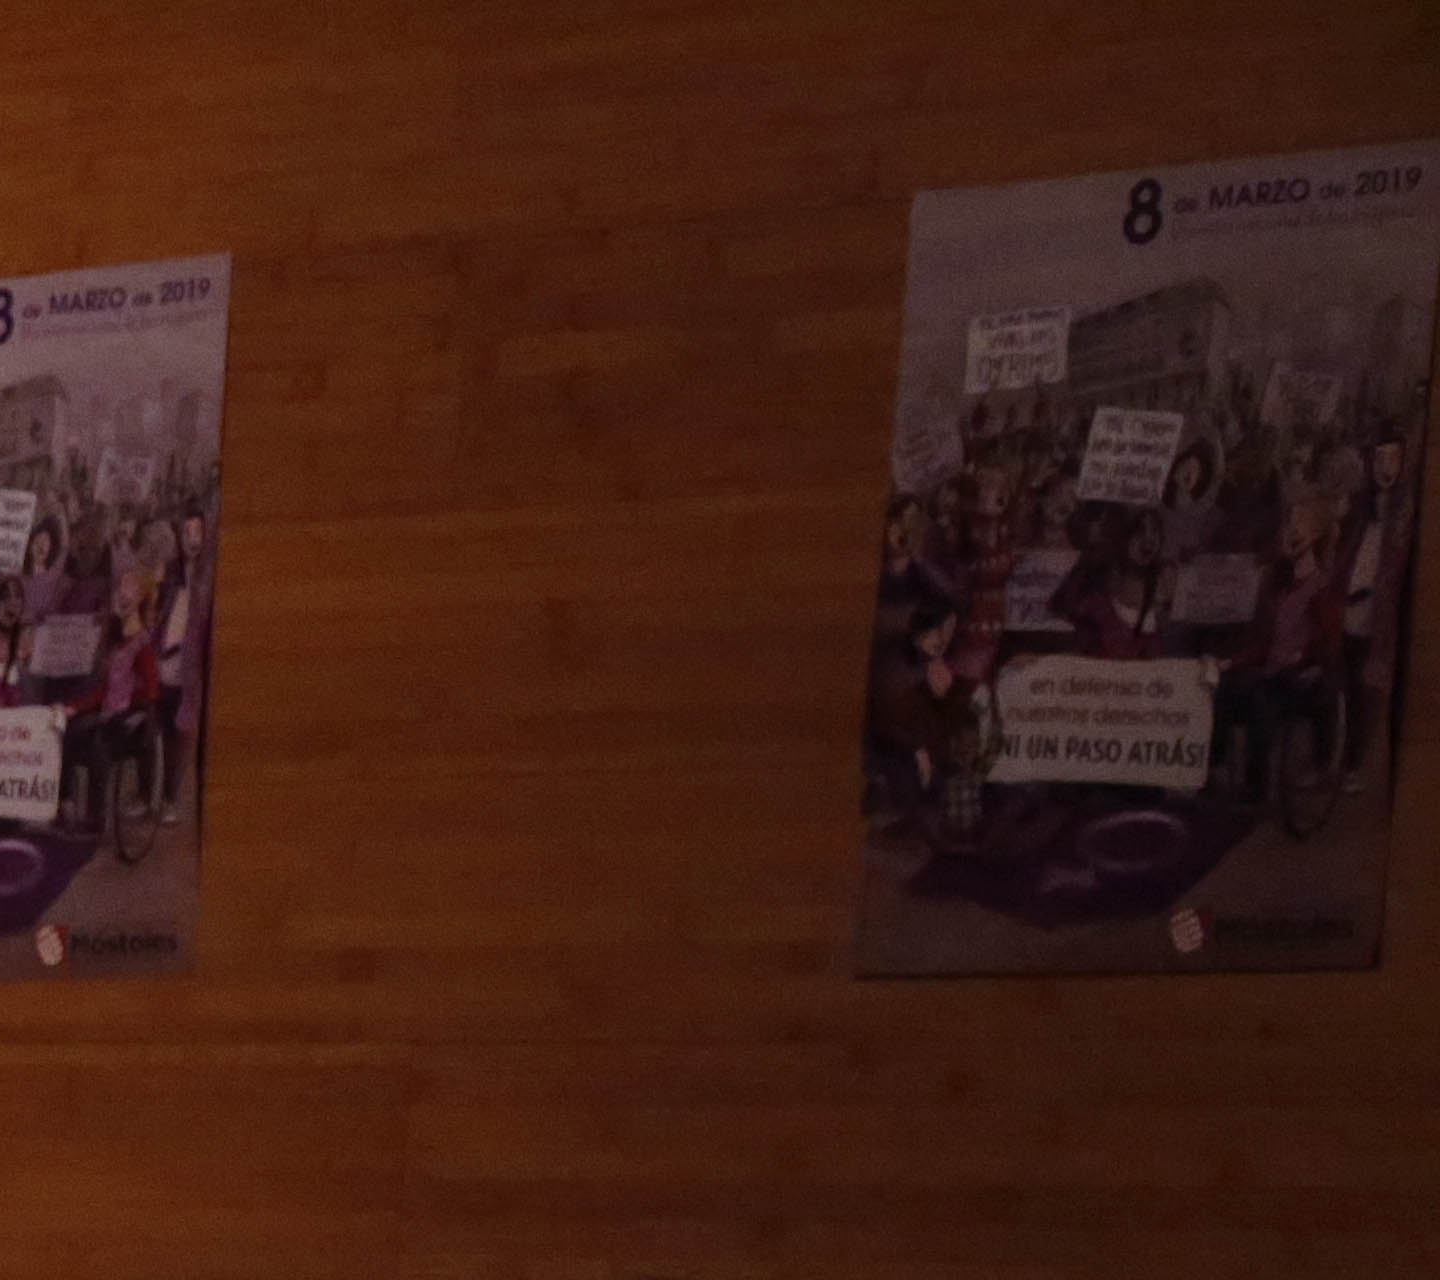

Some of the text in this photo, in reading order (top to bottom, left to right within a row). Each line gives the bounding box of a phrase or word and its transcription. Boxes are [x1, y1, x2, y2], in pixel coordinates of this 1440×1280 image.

[1123, 178, 1163, 245] 8
[1208, 178, 1311, 210] MARZO
[1354, 166, 1422, 197] 2019
[49, 286, 127, 315] MARZO
[161, 277, 211, 304] 2019
[1027, 734, 1059, 760] UN
[1065, 736, 1122, 764] PASO
